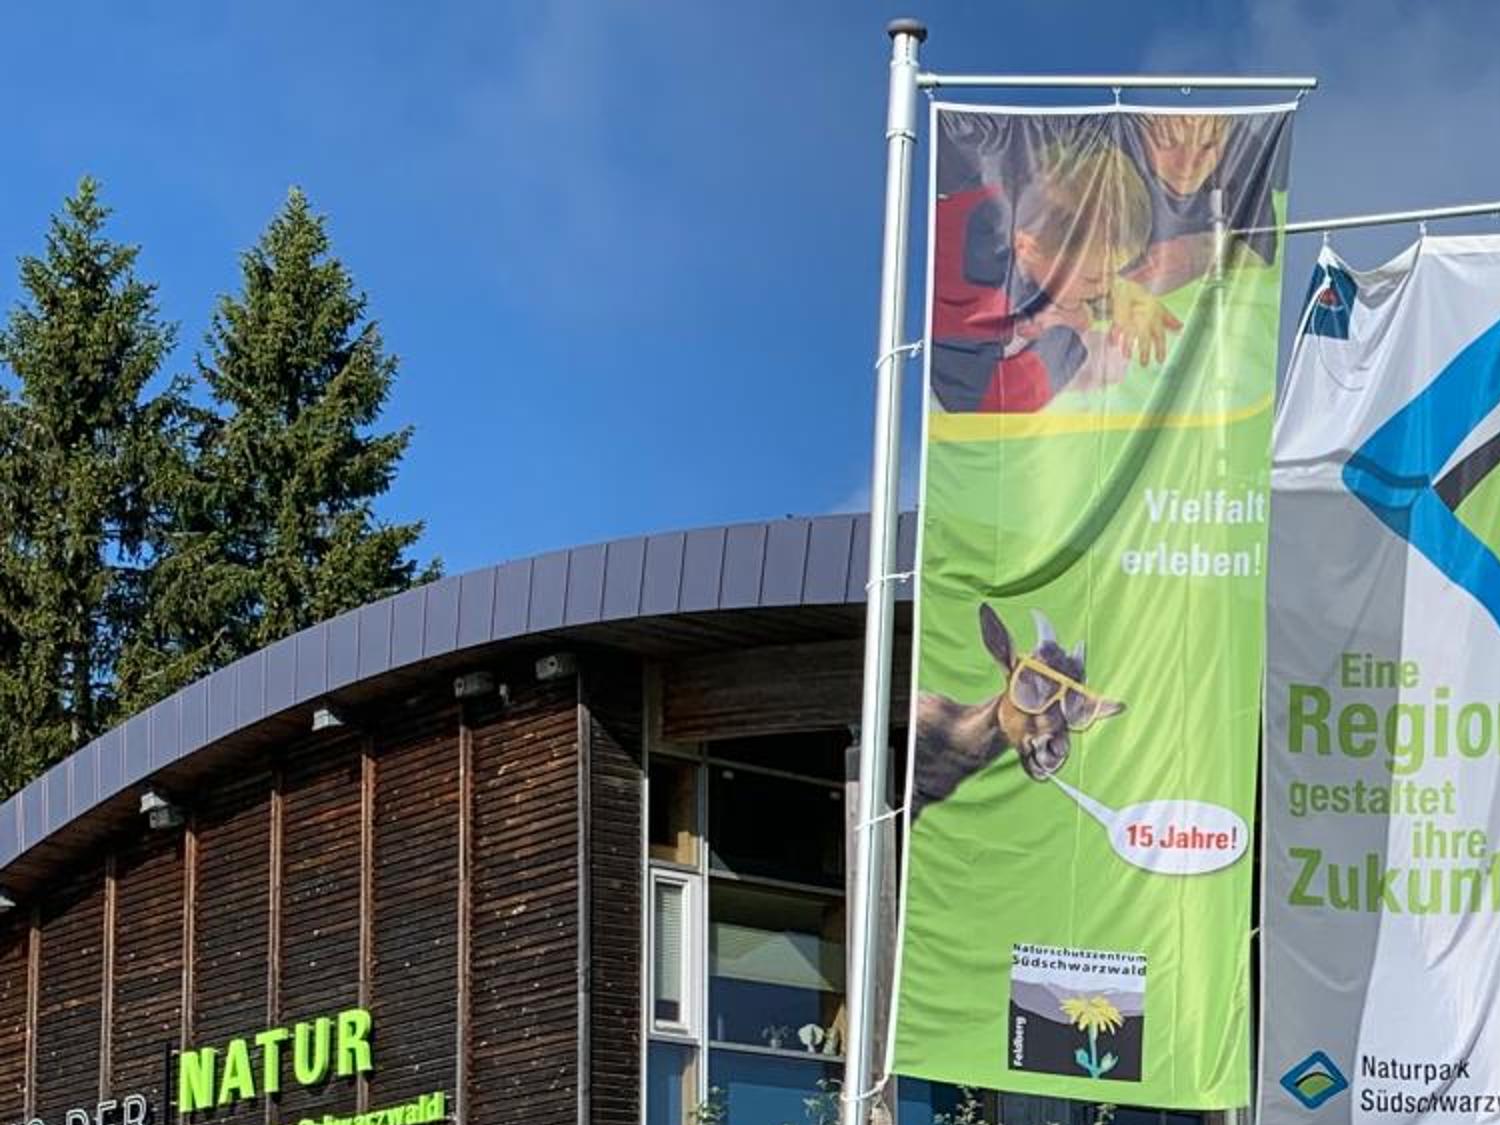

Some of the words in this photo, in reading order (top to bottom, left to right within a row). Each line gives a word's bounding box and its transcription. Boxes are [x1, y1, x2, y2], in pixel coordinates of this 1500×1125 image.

[1144, 488, 1265, 524] Vielfalt
[1121, 541, 1261, 577] erleben!
[1341, 653, 1420, 688] Eine
[1289, 779, 1456, 818] gestaltet
[1127, 824, 1153, 848] 15
[1159, 825, 1237, 849] Jahre!
[1412, 821, 1487, 859] ihre
[1013, 954, 1147, 976] Südschwarzwald
[180, 1008, 373, 1113] NATUR
